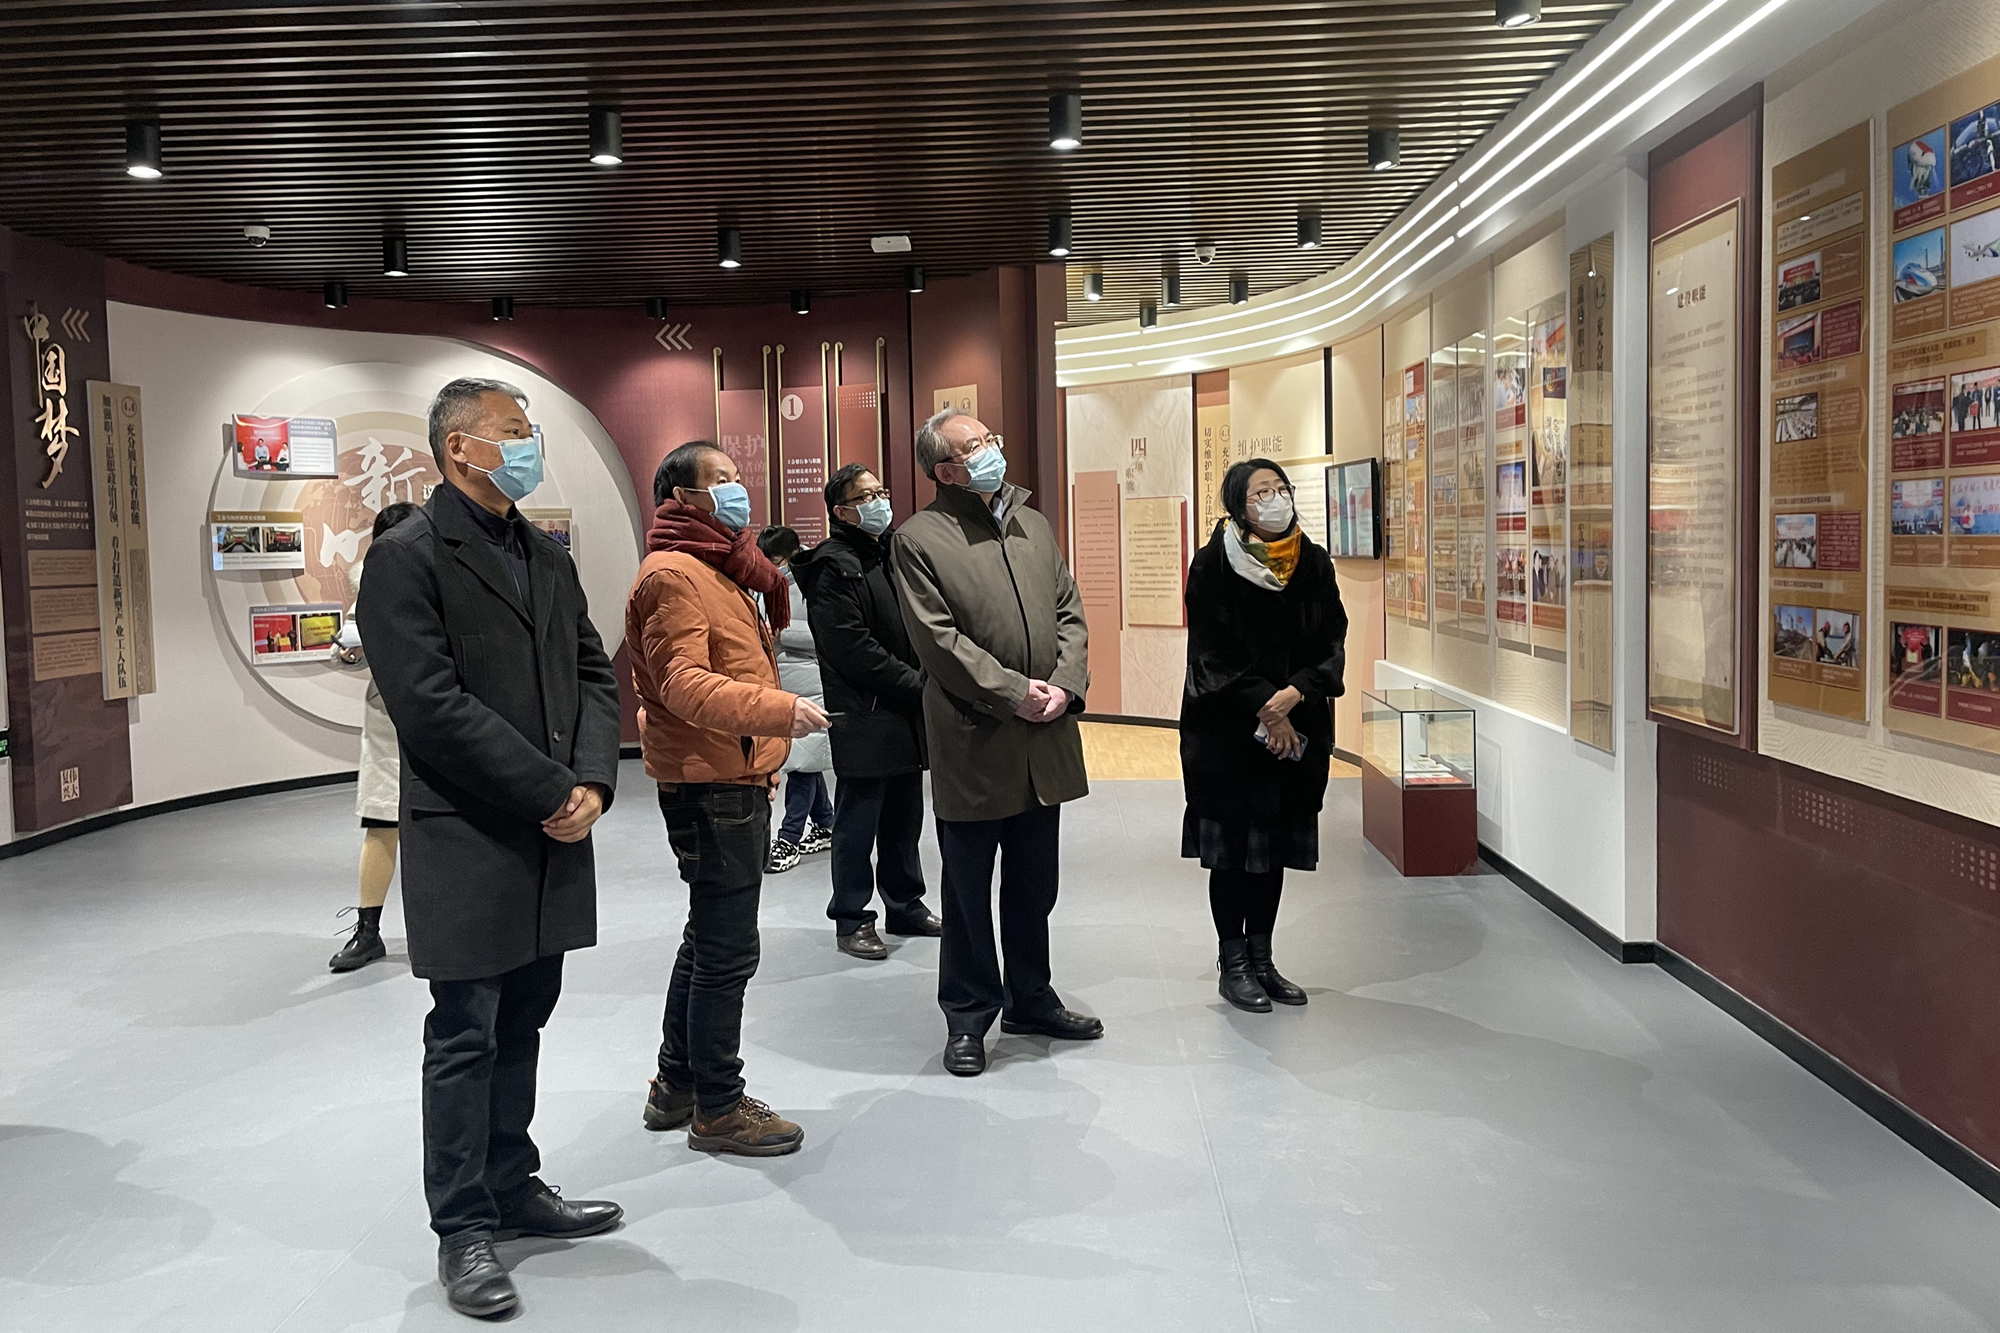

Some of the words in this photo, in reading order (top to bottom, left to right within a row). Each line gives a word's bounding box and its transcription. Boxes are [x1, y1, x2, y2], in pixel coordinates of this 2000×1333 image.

[1678, 285, 1706, 308] 建设职能
[24, 301, 80, 490] 中国梦
[789, 398, 796, 416] 1
[722, 434, 765, 459] 保护
[1238, 435, 1282, 457] 维护职能
[1204, 427, 1213, 537] 切实维护职工合法权益
